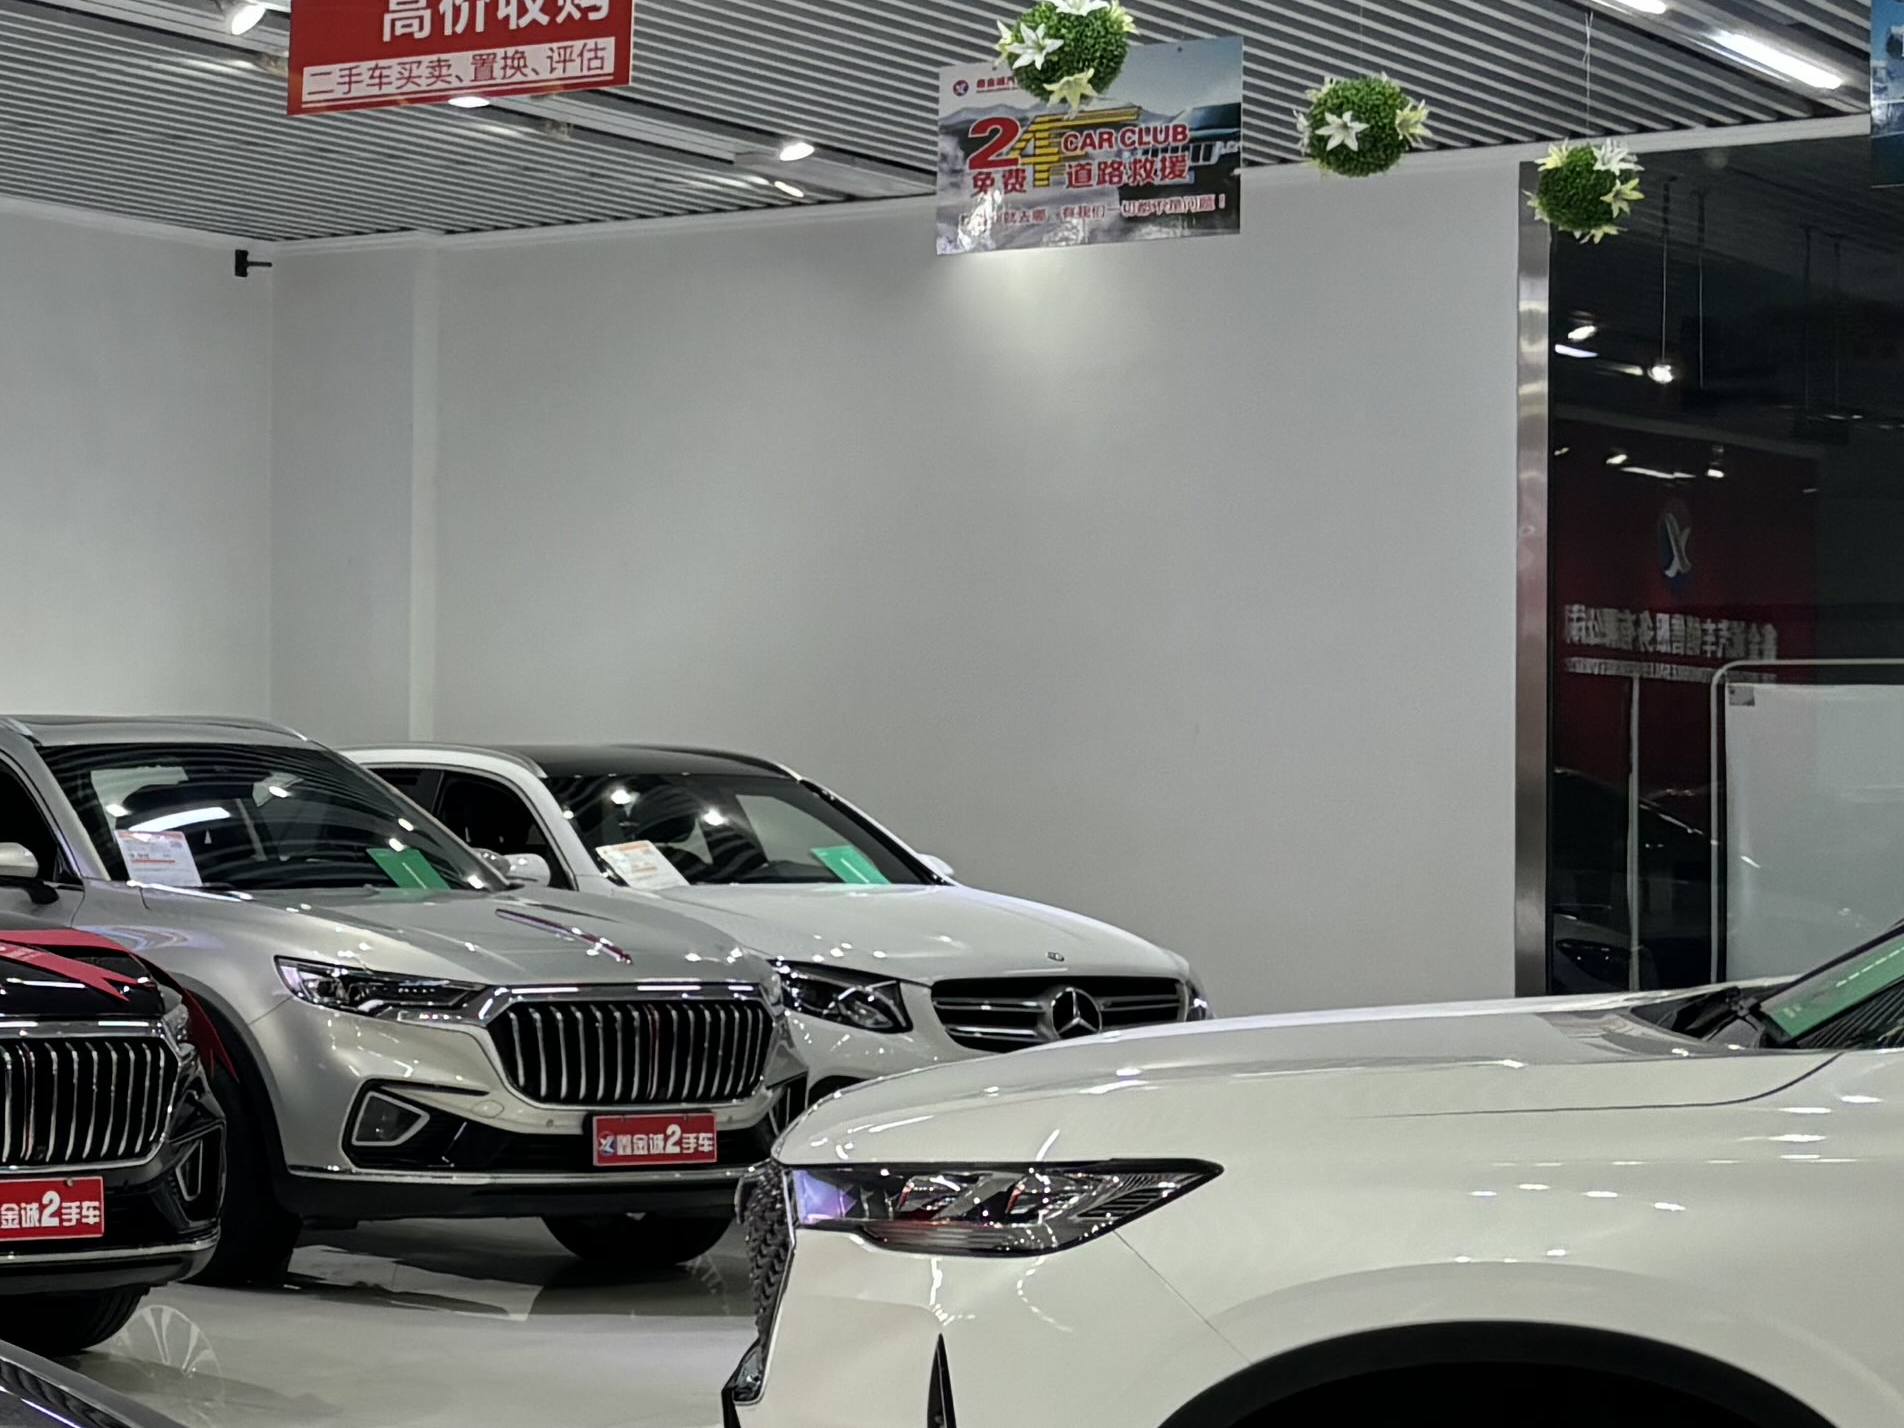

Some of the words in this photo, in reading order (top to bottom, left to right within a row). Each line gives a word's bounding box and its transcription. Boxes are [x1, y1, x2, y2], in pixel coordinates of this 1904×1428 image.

[307, 42, 607, 97] 二手车买卖、置换、评估
[1062, 130, 1116, 153] CAR
[1119, 123, 1191, 150] CLUB
[971, 169, 1028, 197] 免费
[1066, 155, 1190, 188] 道路救援
